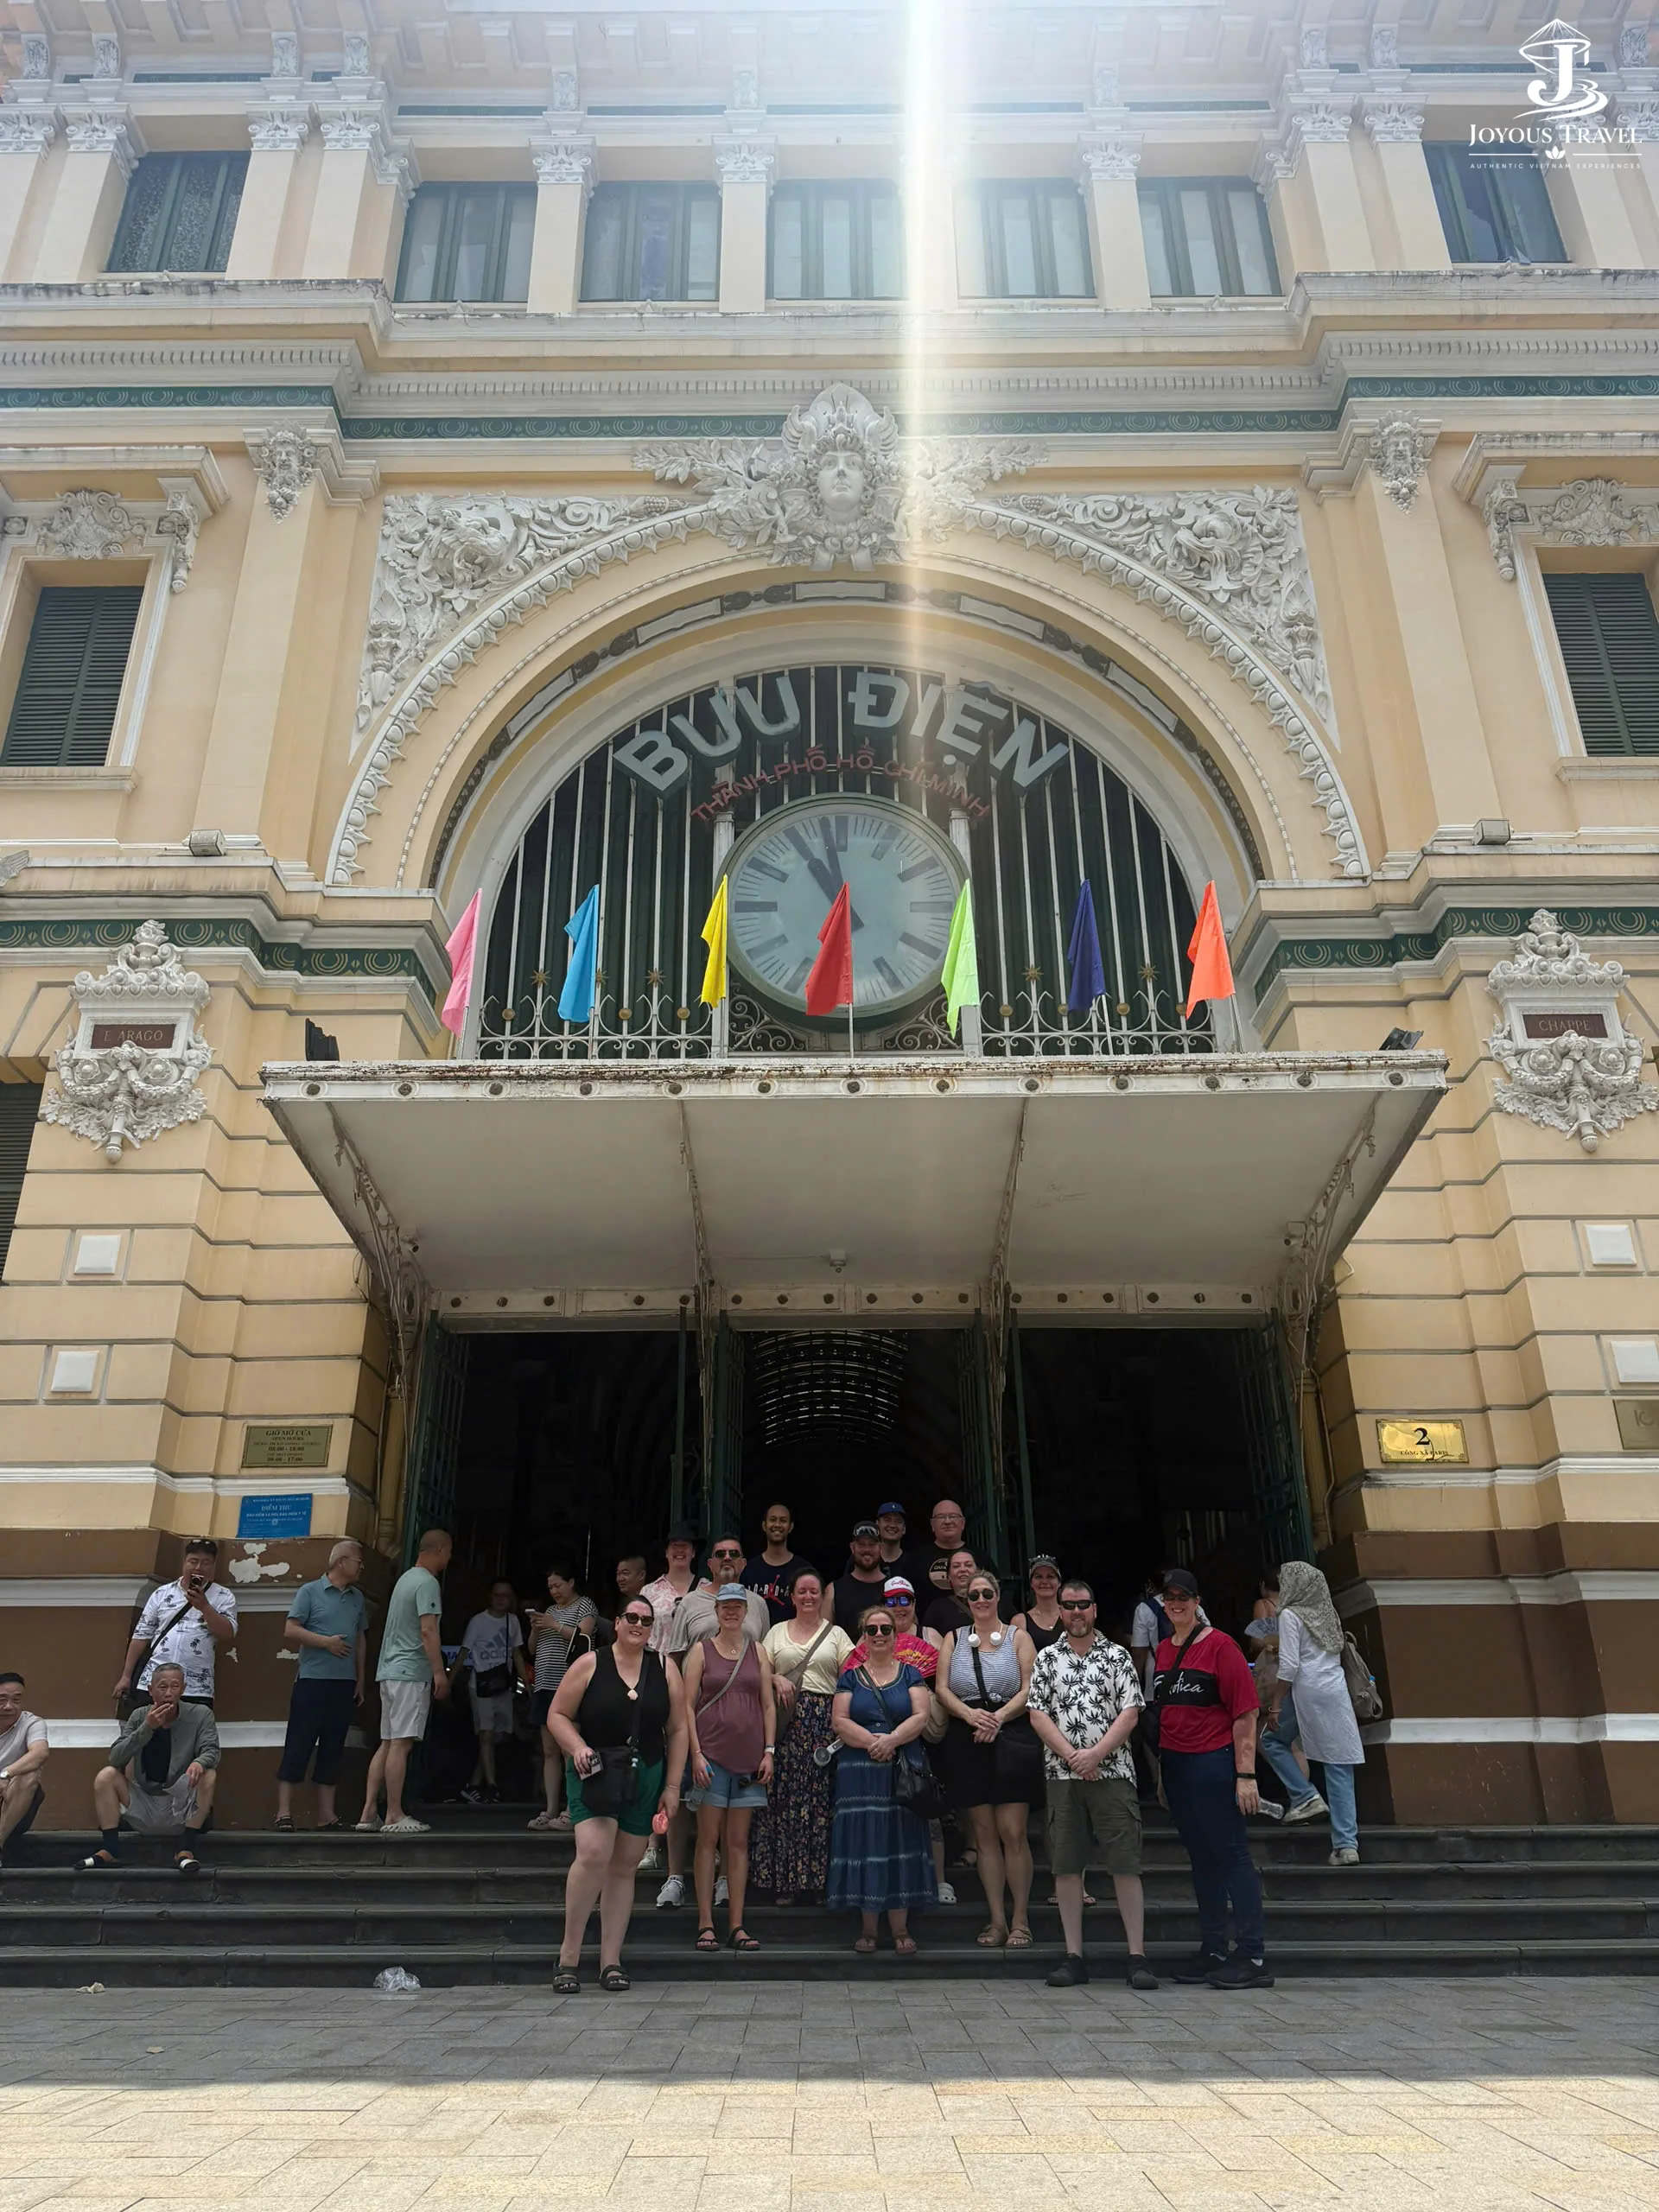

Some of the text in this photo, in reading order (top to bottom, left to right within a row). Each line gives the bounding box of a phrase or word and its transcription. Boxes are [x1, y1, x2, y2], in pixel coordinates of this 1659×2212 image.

[773, 744, 827, 780] PHỐ
[1538, 1020, 1592, 1032] CHAPPE
[117, 1029, 164, 1042] ARAGO
[1414, 1427, 1431, 1446] 2
